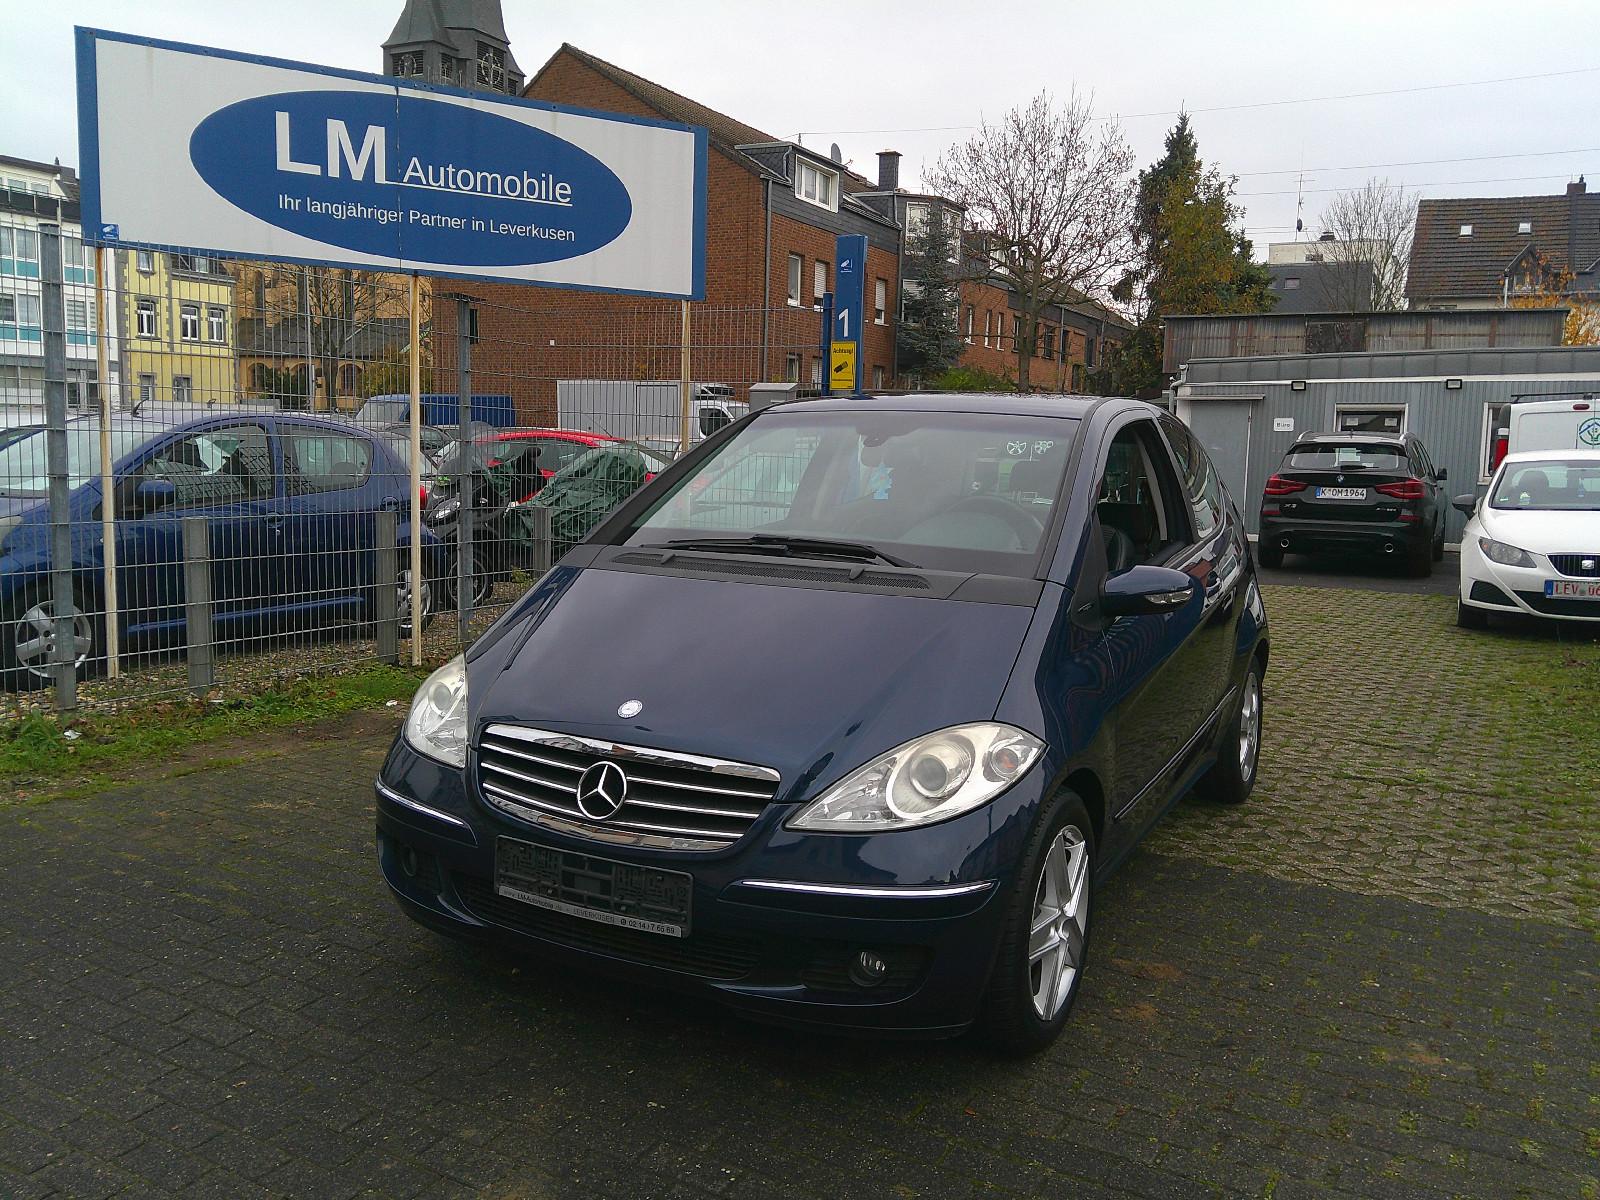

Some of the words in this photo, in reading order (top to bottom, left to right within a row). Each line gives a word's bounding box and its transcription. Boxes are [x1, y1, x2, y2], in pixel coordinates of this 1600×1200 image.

[276, 111, 386, 184] LM
[403, 156, 572, 203] Automobile
[279, 194, 301, 212] Ihr
[307, 196, 403, 224] langjähriger
[409, 209, 466, 230] Partner
[472, 217, 485, 232] in
[490, 219, 575, 242] Leverkusen
[838, 308, 849, 338] 1
[1321, 488, 1328, 497] K
[1555, 583, 1579, 595] LEV
